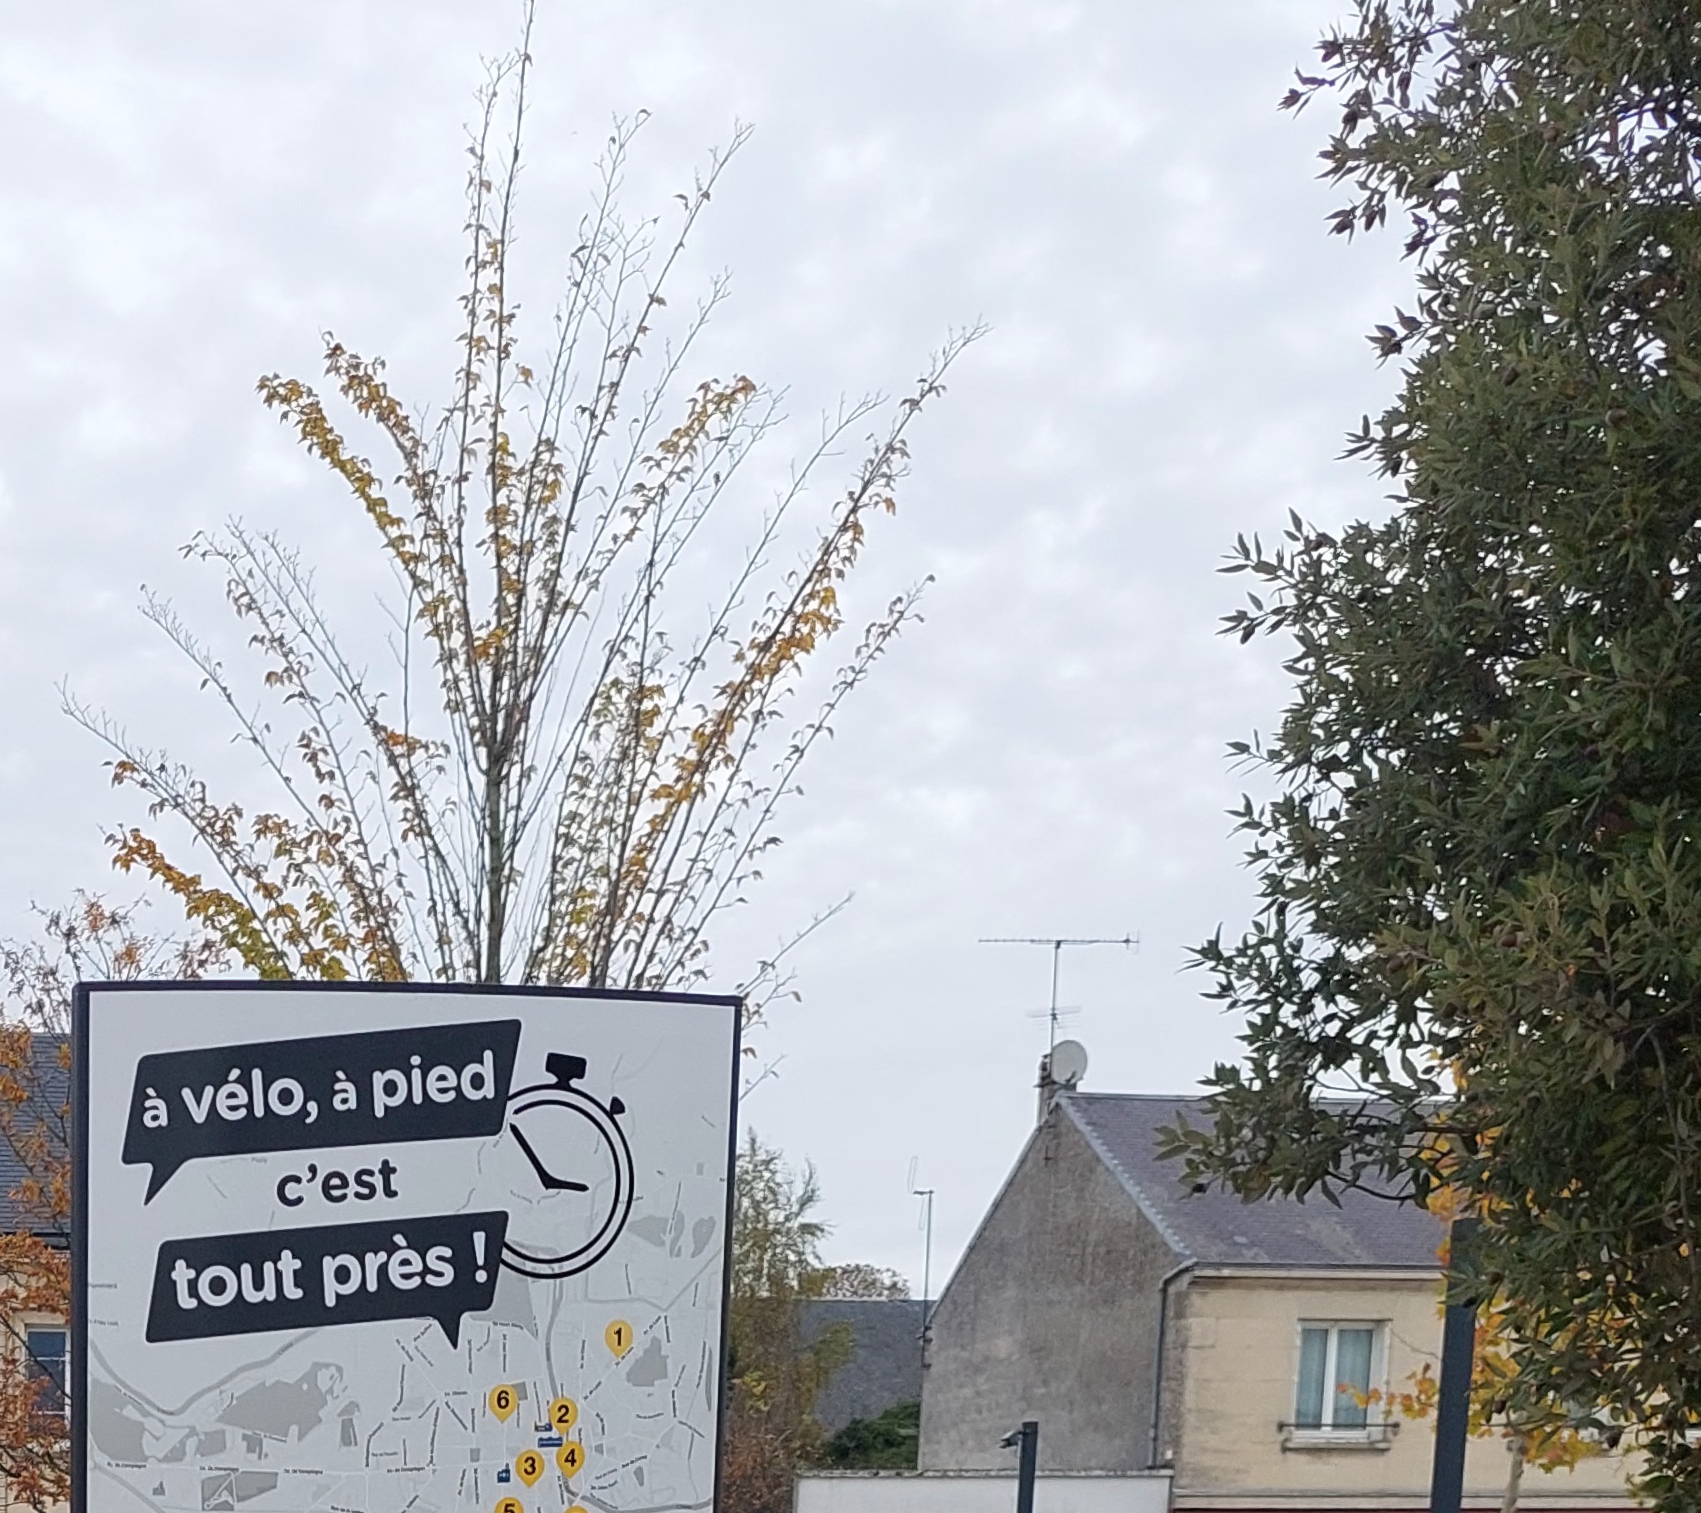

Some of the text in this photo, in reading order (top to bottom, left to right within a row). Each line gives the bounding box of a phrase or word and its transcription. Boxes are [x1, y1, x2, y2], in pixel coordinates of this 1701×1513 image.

[142, 1049, 496, 1129] à vélo, à pied
[171, 1230, 489, 1310] tout près !
[613, 1327, 623, 1347] 1
[497, 1390, 509, 1409] 6
[557, 1405, 569, 1424] 2
[524, 1456, 536, 1476] 3
[564, 1449, 577, 1467] 4
